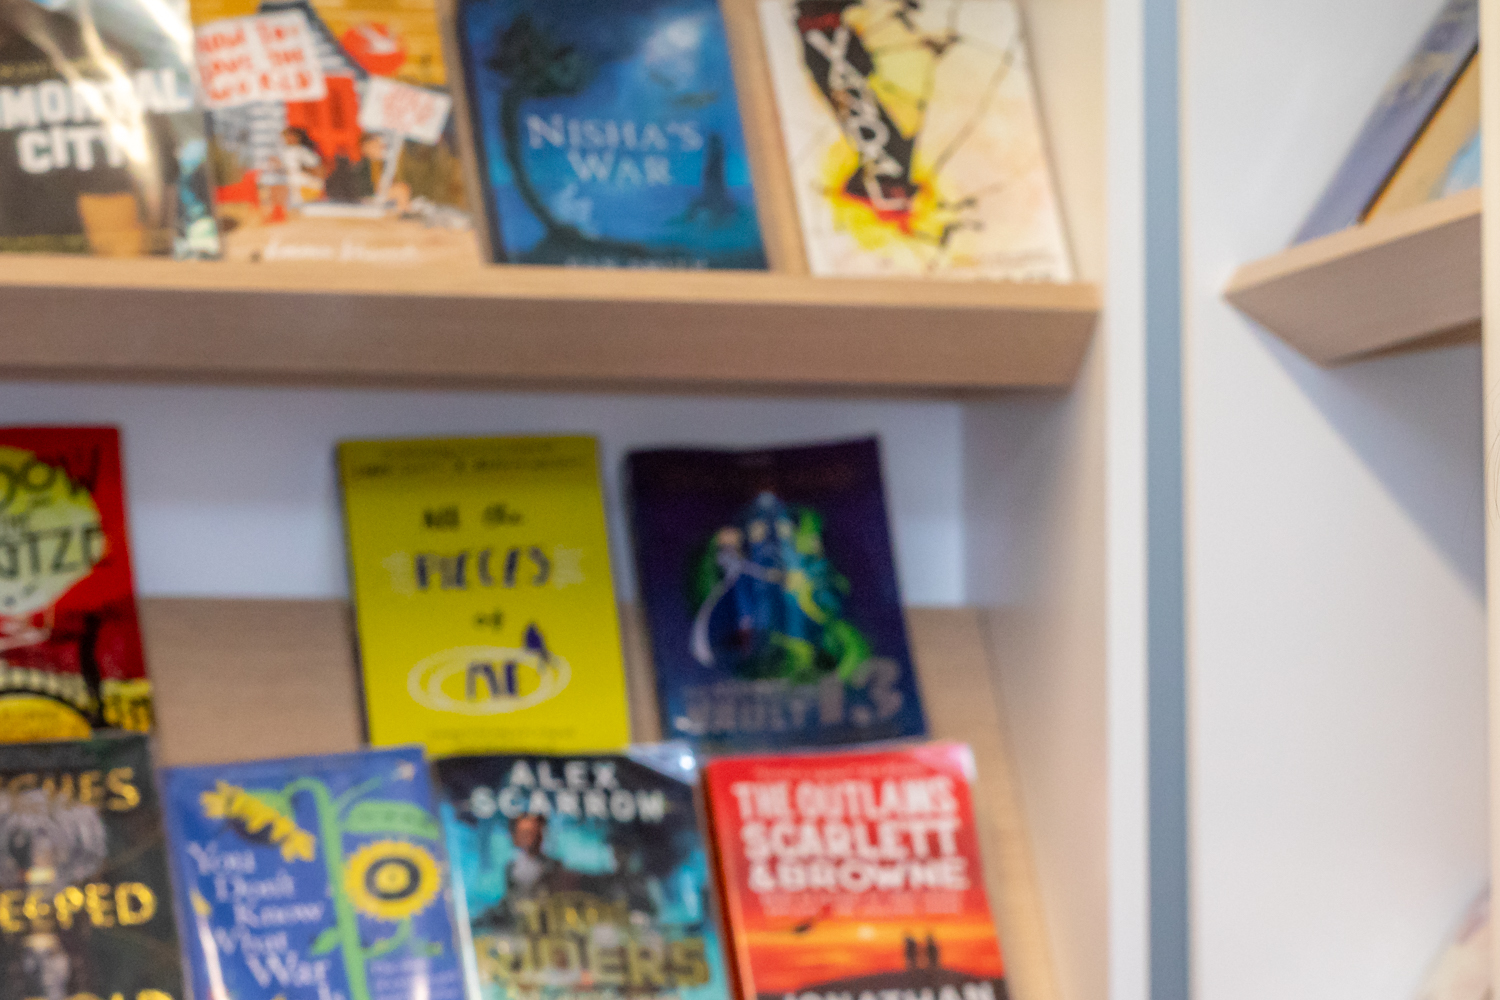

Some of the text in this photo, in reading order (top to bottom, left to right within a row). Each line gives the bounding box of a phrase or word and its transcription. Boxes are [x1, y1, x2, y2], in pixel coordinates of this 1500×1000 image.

[527, 114, 703, 150] NISHA'S
[567, 150, 671, 186] WAR
[508, 760, 619, 789] ALEX
[470, 788, 666, 824] SCARROW
[731, 780, 794, 822] THE
[739, 817, 961, 864] SCARLETT
[187, 842, 257, 876] You
[233, 903, 325, 928] Know
[243, 955, 332, 989] War
